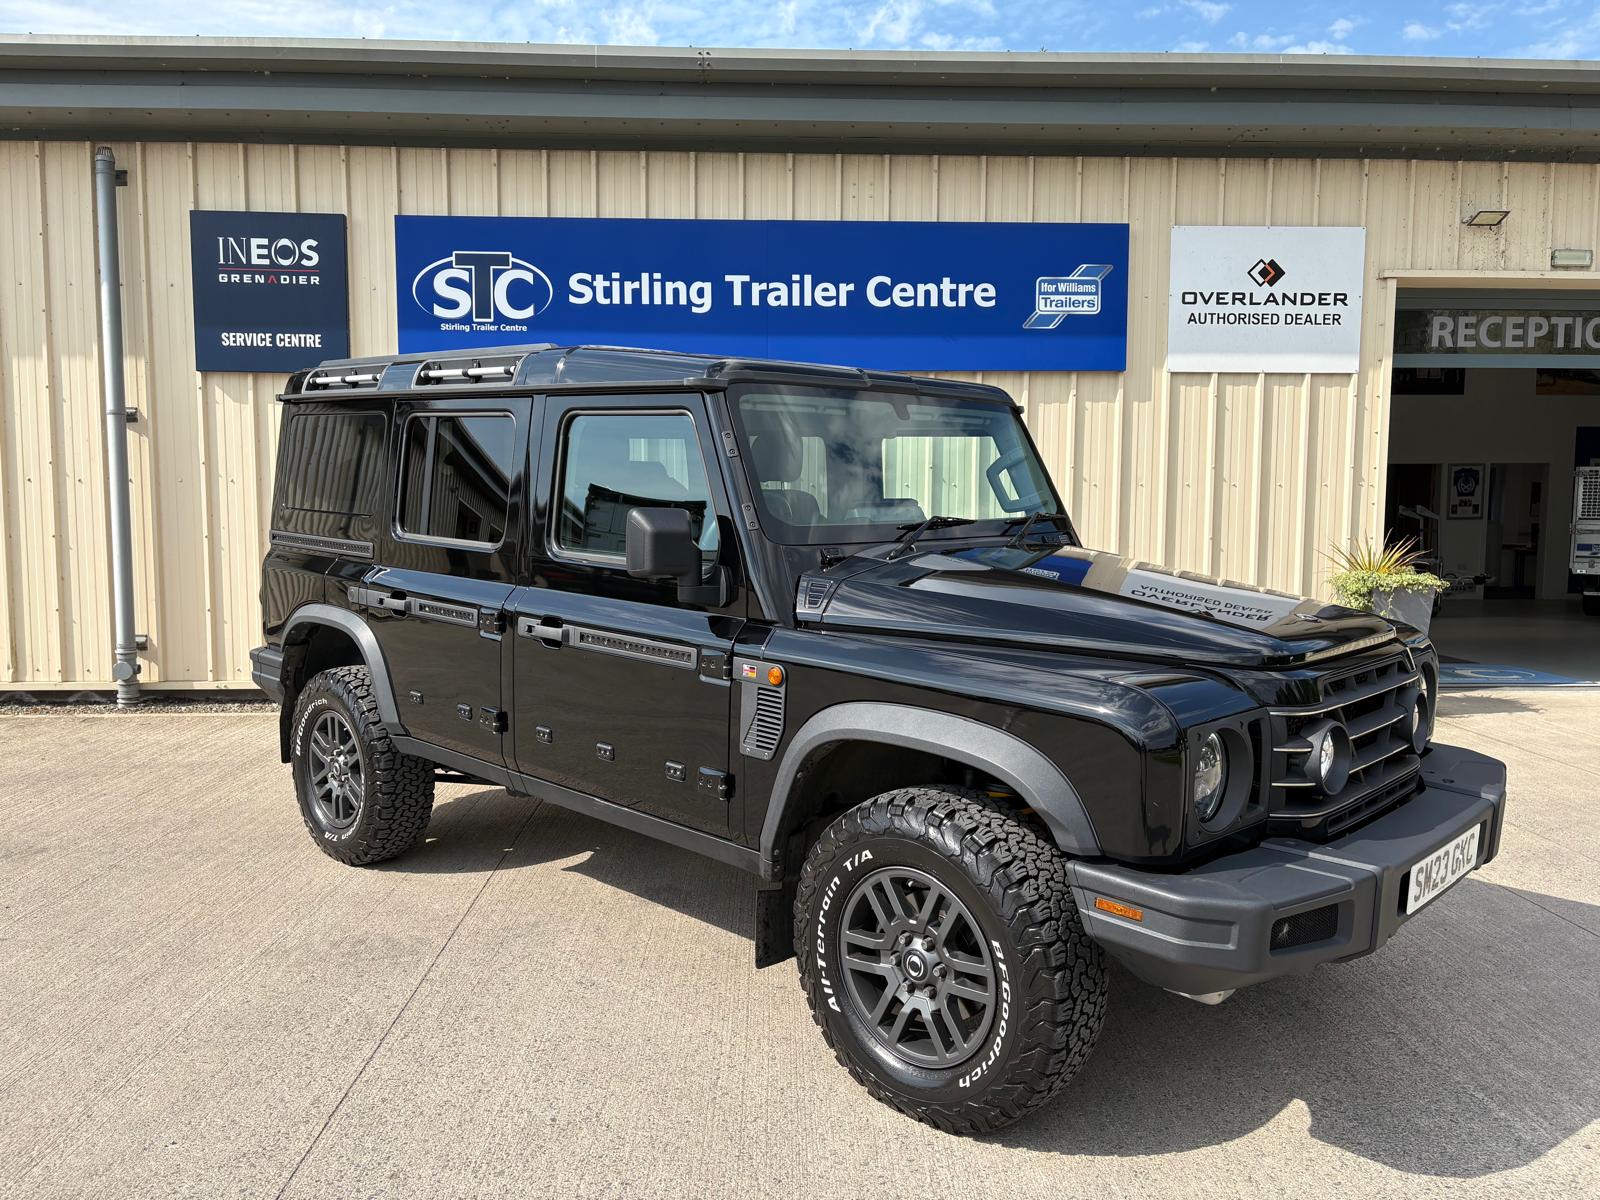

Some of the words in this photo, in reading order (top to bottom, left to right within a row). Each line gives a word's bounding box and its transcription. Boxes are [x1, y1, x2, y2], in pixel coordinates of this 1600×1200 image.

[217, 236, 320, 267] INEOS
[218, 273, 320, 286] GRENADIER
[432, 251, 536, 323] STC
[1041, 282, 1056, 293] Ifor
[1058, 282, 1096, 293] Williams
[567, 271, 713, 314] Stirling
[725, 273, 854, 308] Trailer
[865, 275, 997, 308] Centre
[1041, 296, 1096, 308] Trailers
[1181, 291, 1349, 307] OVERLANDER
[440, 322, 470, 333] Stirling
[472, 323, 499, 332] Trailer
[500, 323, 528, 332] Centre
[1187, 312, 1280, 326] AUTHORISED
[1284, 312, 1342, 326] DEALER
[221, 331, 273, 348] SERVICE
[275, 333, 322, 348] CENTRE
[295, 698, 328, 757] BFGoodrich
[1413, 849, 1450, 903] SM23
[1450, 832, 1476, 876] GKC
[815, 875, 842, 1014] All-Terrain
[843, 848, 874, 873] T/A
[958, 939, 1012, 1089] BFGoodrich
